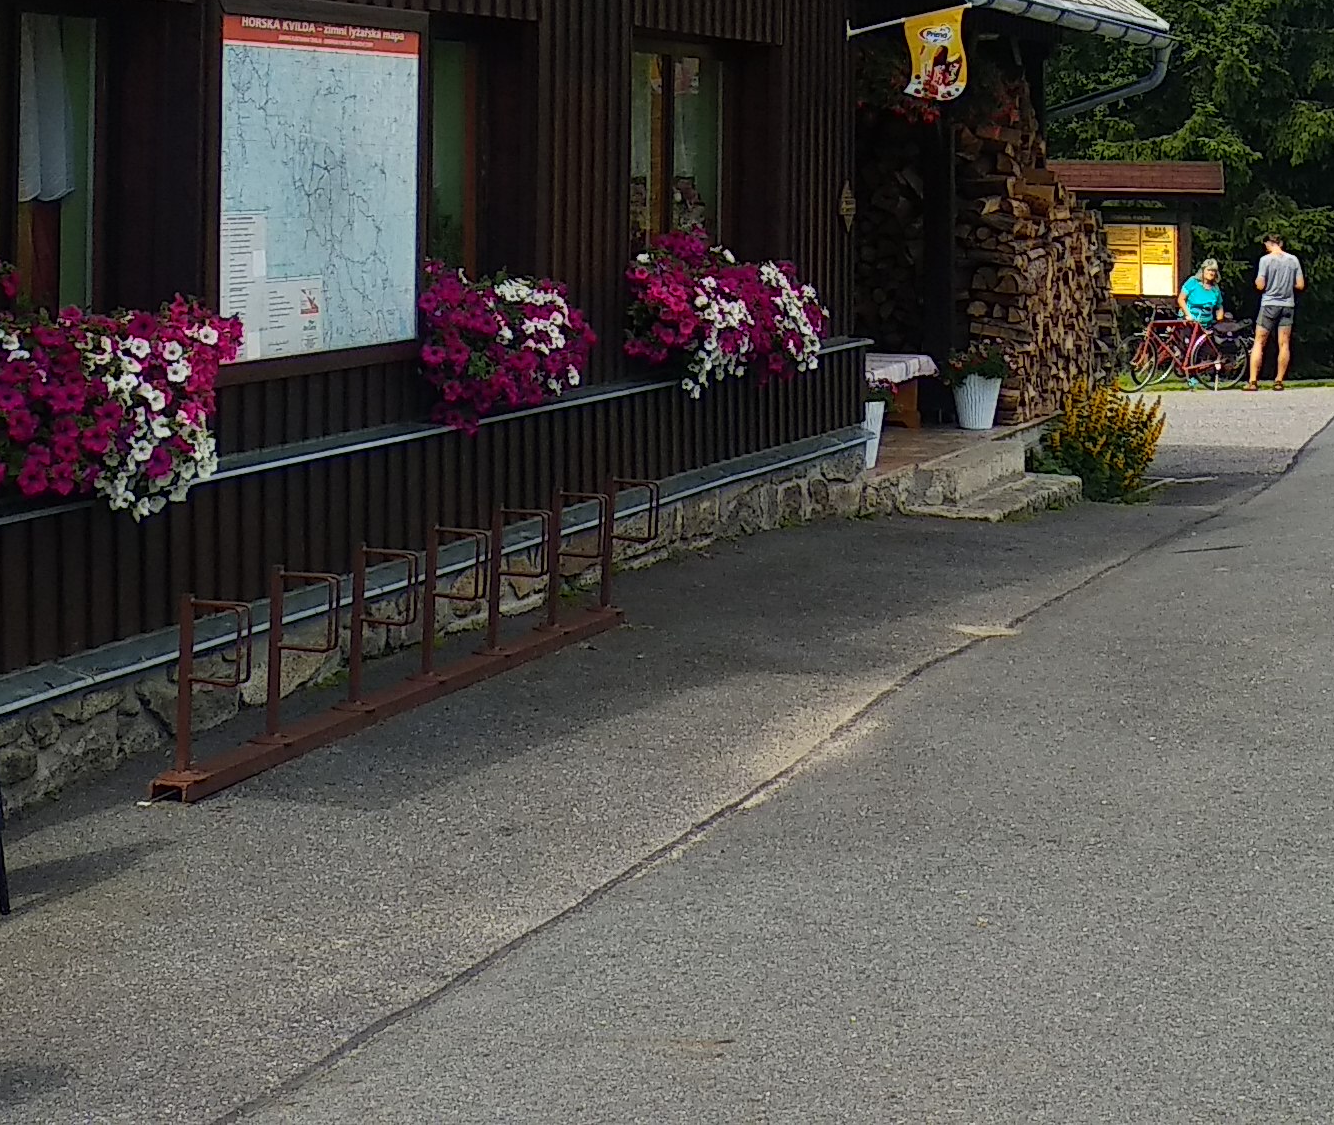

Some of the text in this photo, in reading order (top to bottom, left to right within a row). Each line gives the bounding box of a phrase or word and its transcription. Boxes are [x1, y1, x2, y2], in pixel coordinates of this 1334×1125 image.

[282, 20, 316, 34] KVILDA
[323, 24, 348, 36] zimní
[382, 31, 405, 43] mapa
